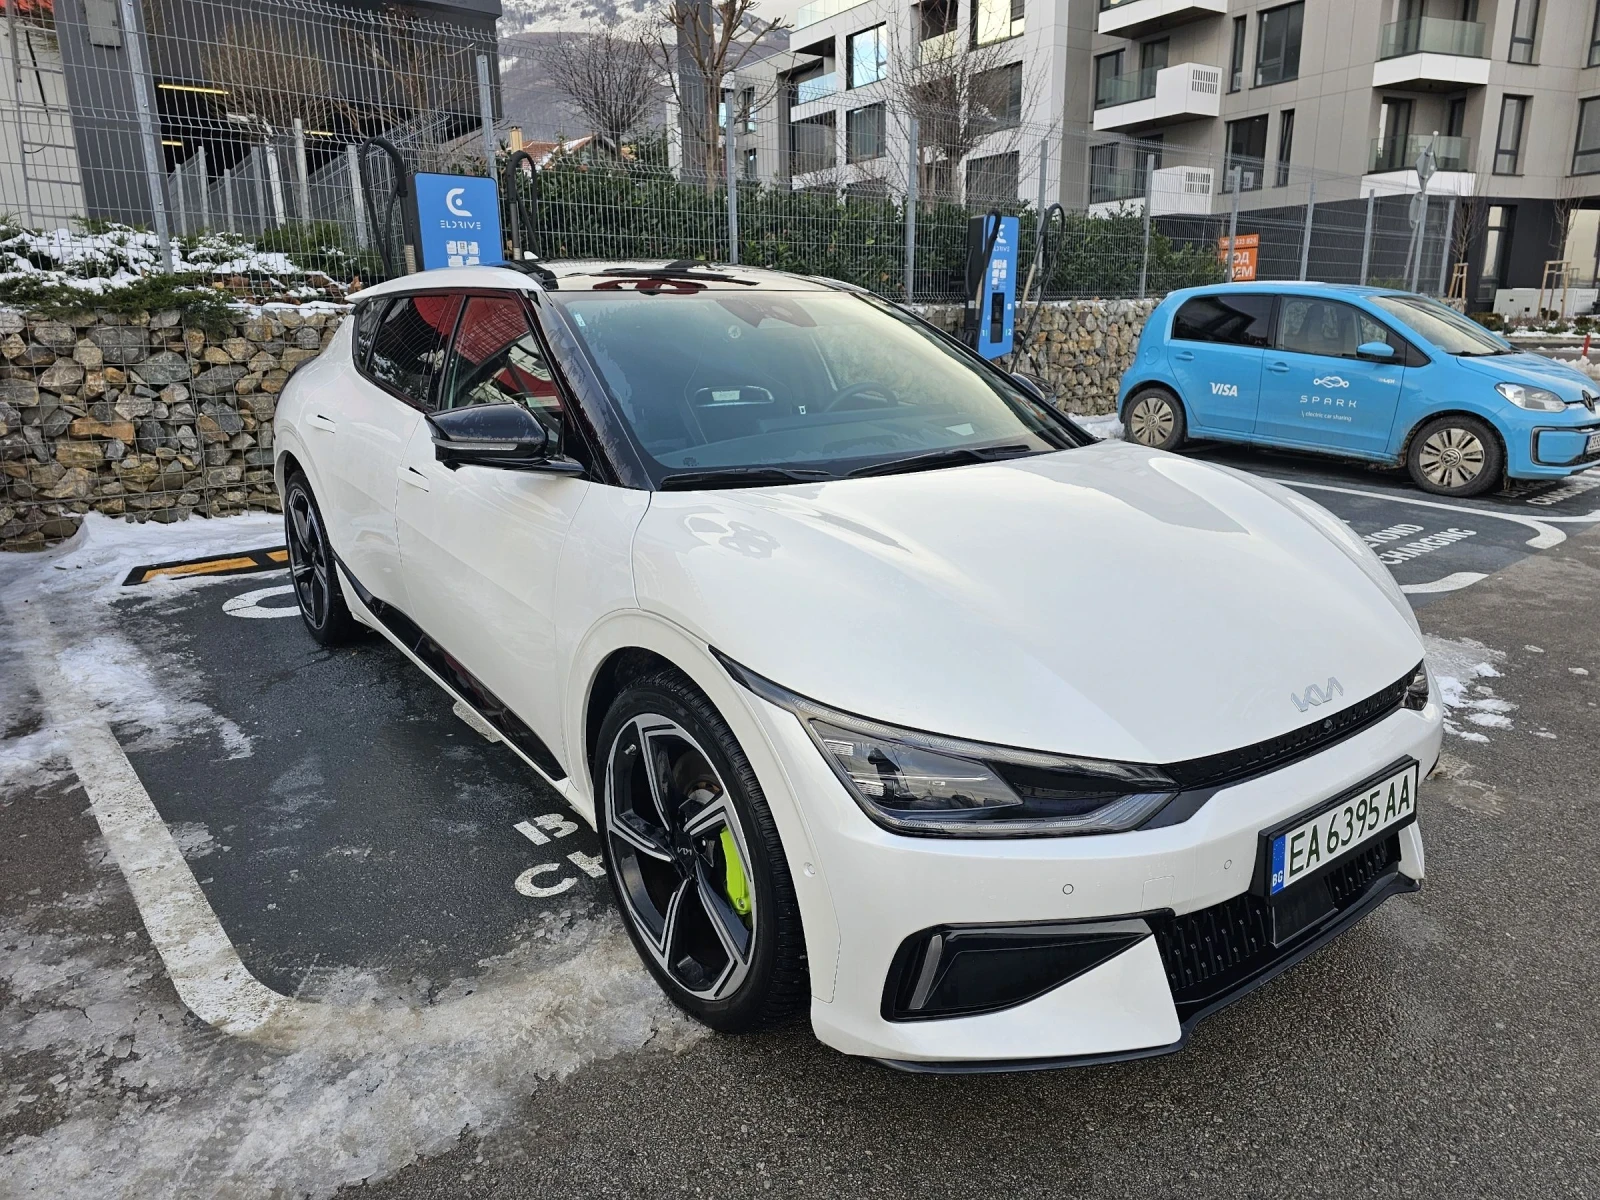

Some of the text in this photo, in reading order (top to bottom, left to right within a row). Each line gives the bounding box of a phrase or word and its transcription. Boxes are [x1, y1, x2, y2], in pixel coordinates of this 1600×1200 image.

[440, 220, 481, 229] ELDRIVE
[1210, 382, 1238, 397] VISA
[1300, 395, 1357, 408] SPARK
[1333, 413, 1352, 422] sharing
[1291, 677, 1344, 712] KIA
[1288, 774, 1410, 878] EA 6395 AA
[1272, 871, 1283, 887] BG
